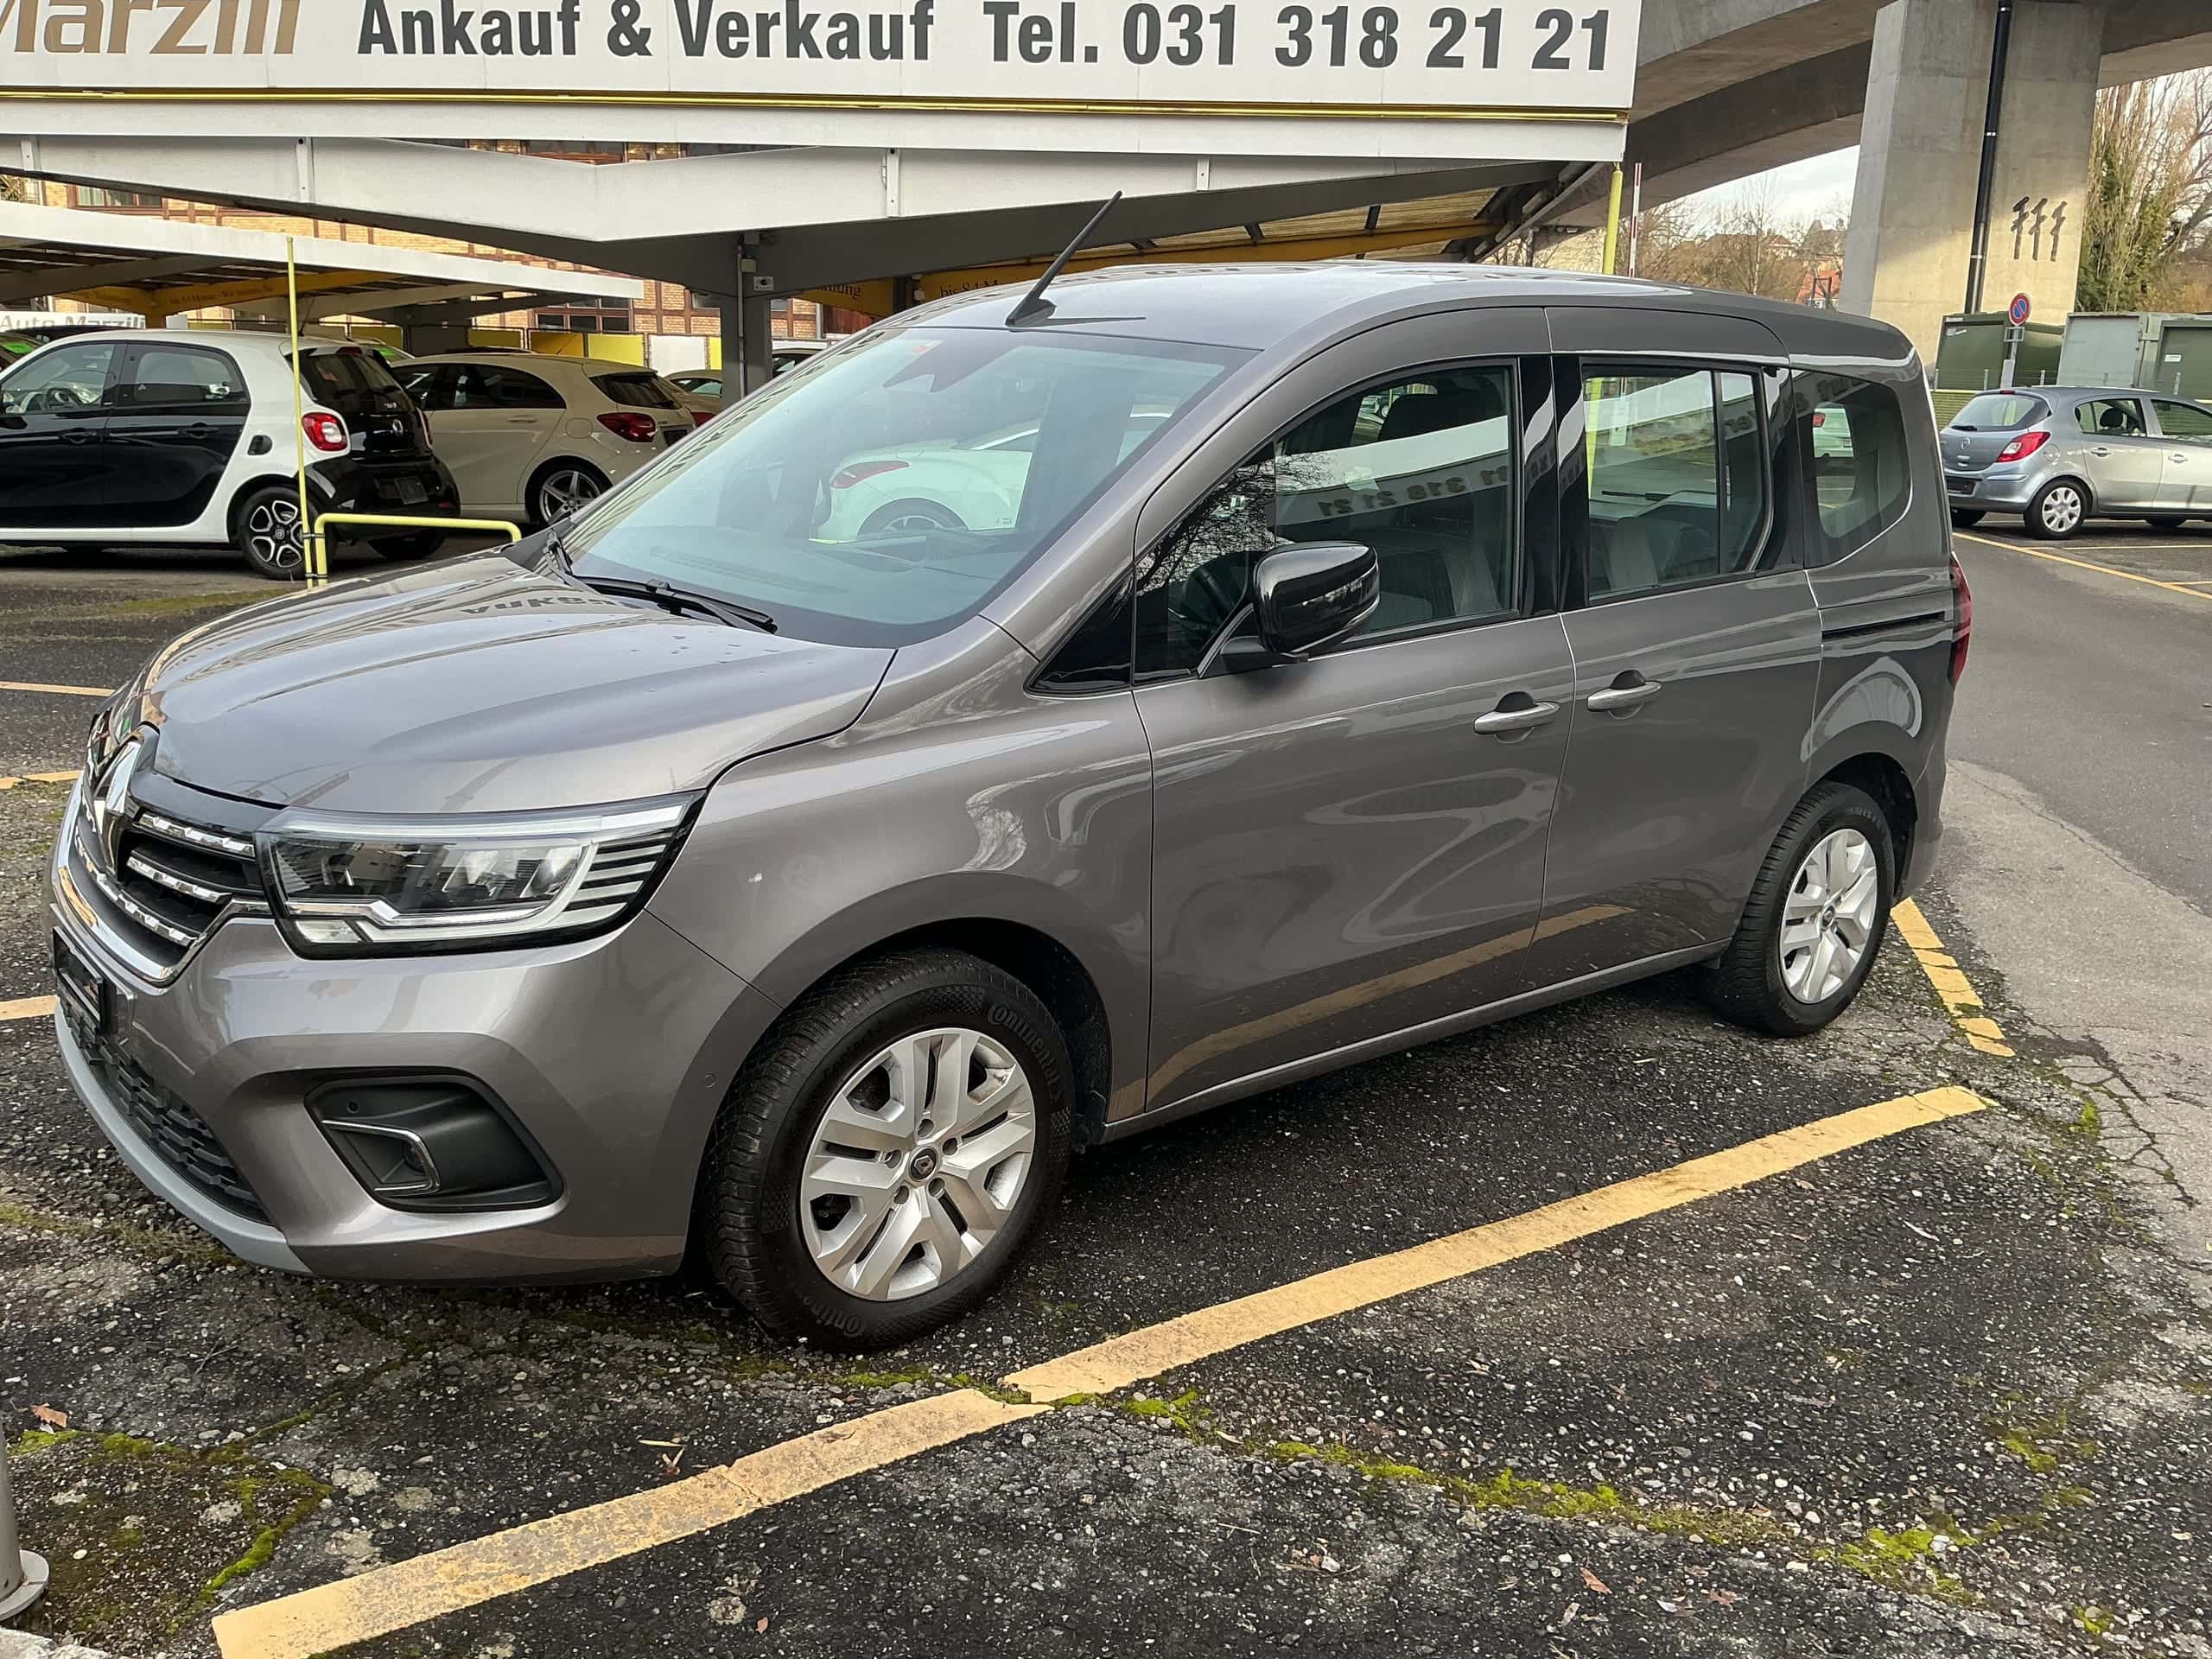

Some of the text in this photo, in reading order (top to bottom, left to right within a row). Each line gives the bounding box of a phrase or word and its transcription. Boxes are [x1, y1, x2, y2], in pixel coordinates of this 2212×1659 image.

[358, 0, 1609, 70] Ankauf & Verkauf Tel. 031 318 21 21
